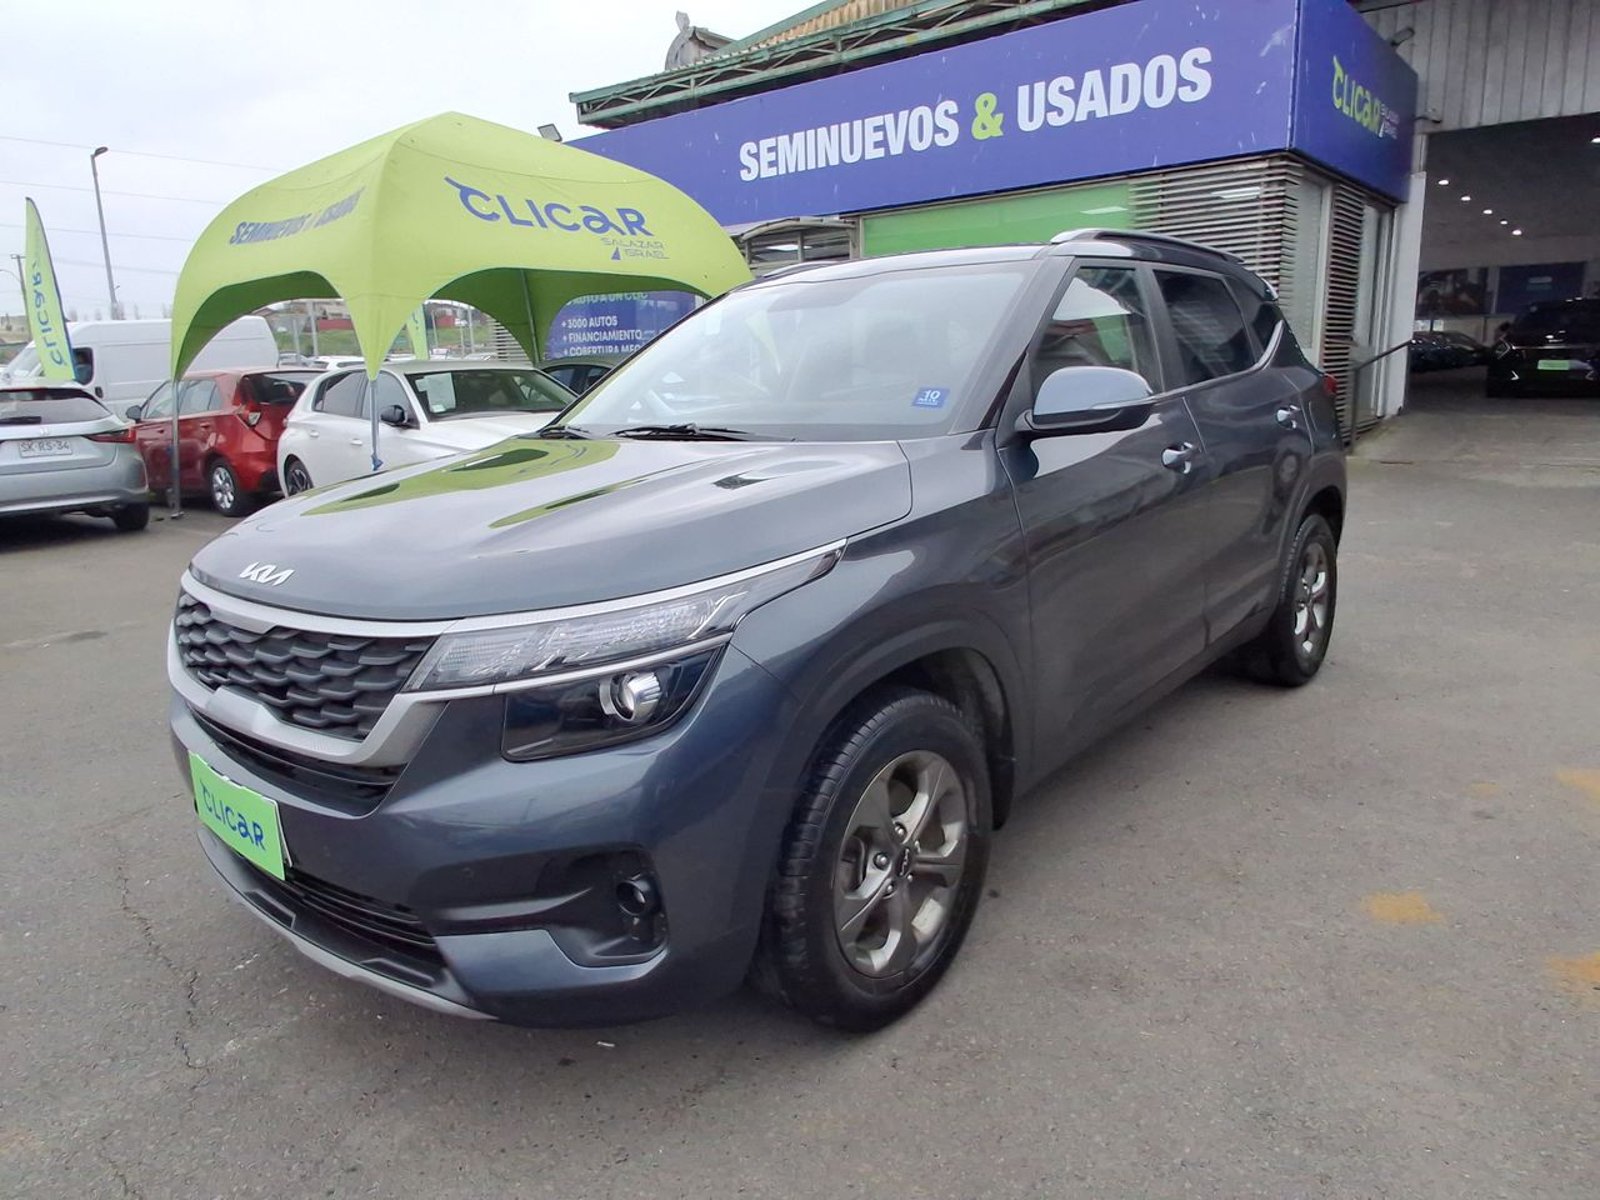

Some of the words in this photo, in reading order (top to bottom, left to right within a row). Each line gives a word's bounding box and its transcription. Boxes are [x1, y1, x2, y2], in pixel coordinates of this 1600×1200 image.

[739, 100, 960, 181] SEMINUEVOS
[970, 92, 1003, 141] &
[1017, 47, 1212, 132] USADOS
[568, 318, 587, 329] 3000
[589, 316, 618, 328] AUTOS
[568, 330, 642, 343] FINANCIAMIENTO
[239, 561, 295, 586] KIA
